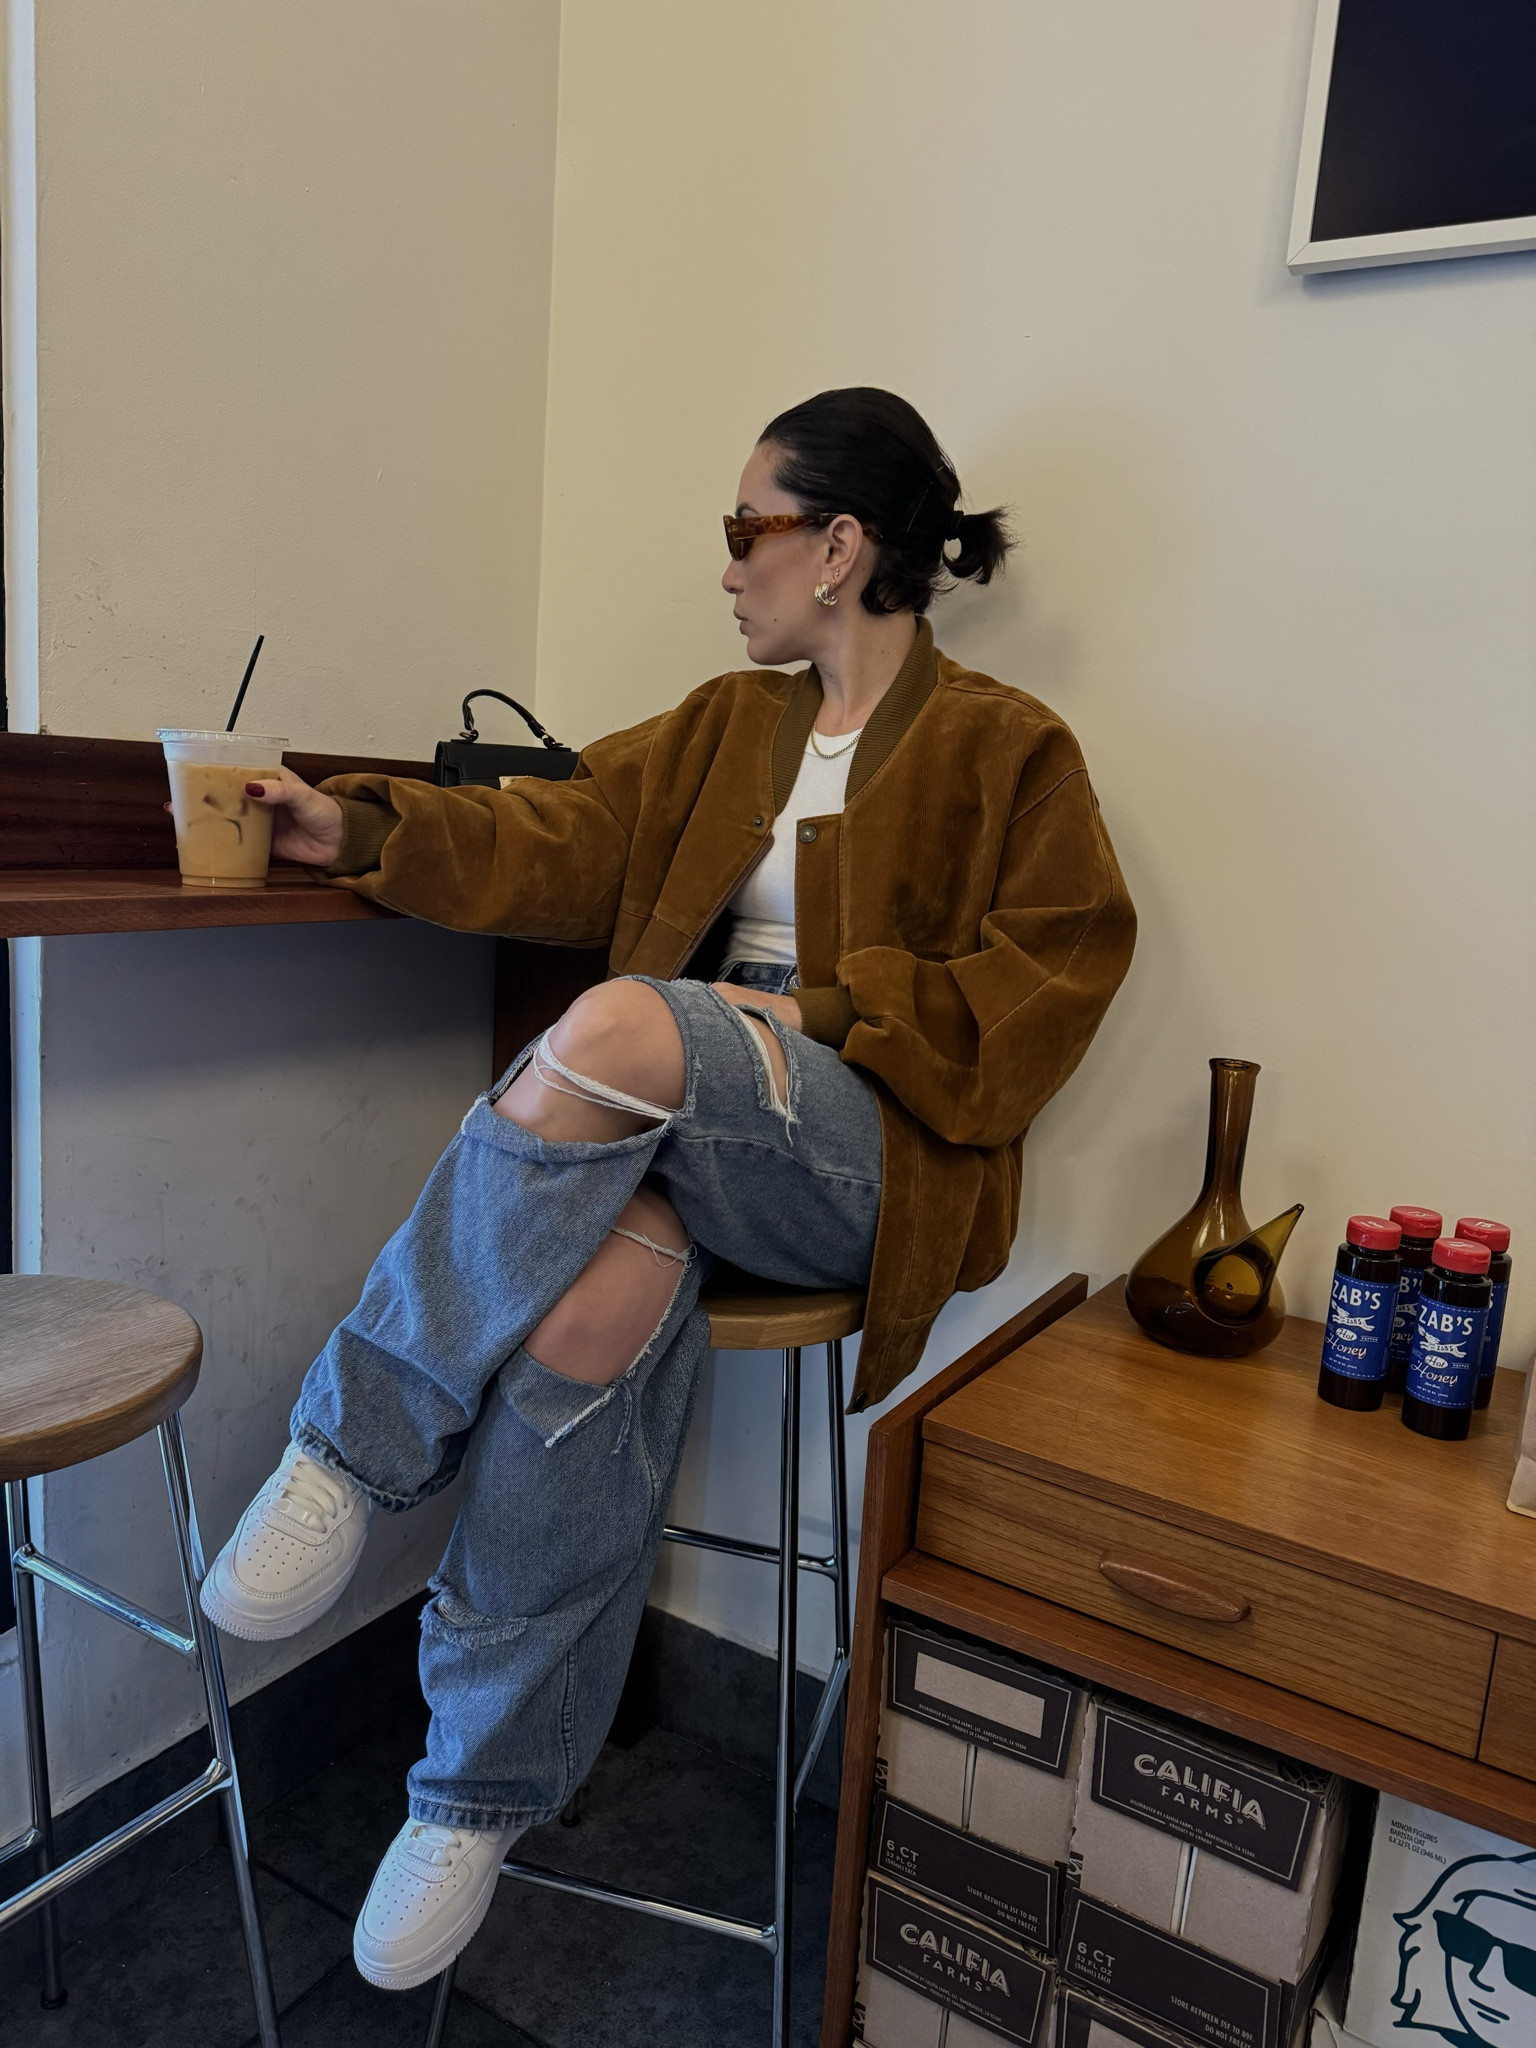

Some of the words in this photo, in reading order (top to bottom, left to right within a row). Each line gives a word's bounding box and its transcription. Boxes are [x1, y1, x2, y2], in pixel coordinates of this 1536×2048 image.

[1332, 1279, 1381, 1310] ZAB'S
[1419, 1304, 1473, 1336] ZAB'S
[1337, 1328, 1354, 1340] Hot
[1325, 1333, 1367, 1359] Honey
[1436, 1343, 1454, 1352] ZABS
[1425, 1355, 1446, 1368] Hot
[1411, 1360, 1458, 1387] Honey
[1133, 1753, 1267, 1831] CALIFIA
[1390, 1828, 1413, 1842] BARISTA
[1414, 1837, 1425, 1847] OAT
[1391, 1820, 1412, 1833] MINOR
[1413, 1828, 1438, 1843] FIGURES
[886, 1839, 895, 1851] 6
[899, 1846, 919, 1862] CT
[1421, 1849, 1434, 1859] (946
[1435, 1854, 1447, 1865] ML)
[896, 1855, 905, 1864] FL
[906, 1861, 917, 1870] OZ
[904, 1866, 916, 1876] EACH
[967, 1885, 982, 1898] STORE
[983, 1893, 1008, 1910] BETWEEN
[1009, 1905, 1018, 1914] 35F
[1005, 1913, 1017, 1923] NOT
[900, 1923, 1010, 1998] CALIFIA
[1075, 1953, 1086, 1963] 32
[1087, 1959, 1098, 1970] FL
[1100, 1966, 1112, 1977] OZ
[1077, 1941, 1087, 1954] 6
[1093, 1949, 1115, 1967] CT
[1097, 1972, 1111, 1984] EACH
[1170, 1995, 1189, 2010] STORE
[1190, 2005, 1219, 2024] BETWEEN
[1220, 2019, 1230, 2030] 35F
[1204, 2023, 1214, 2034] DO
[1215, 2029, 1227, 2040] NOT
